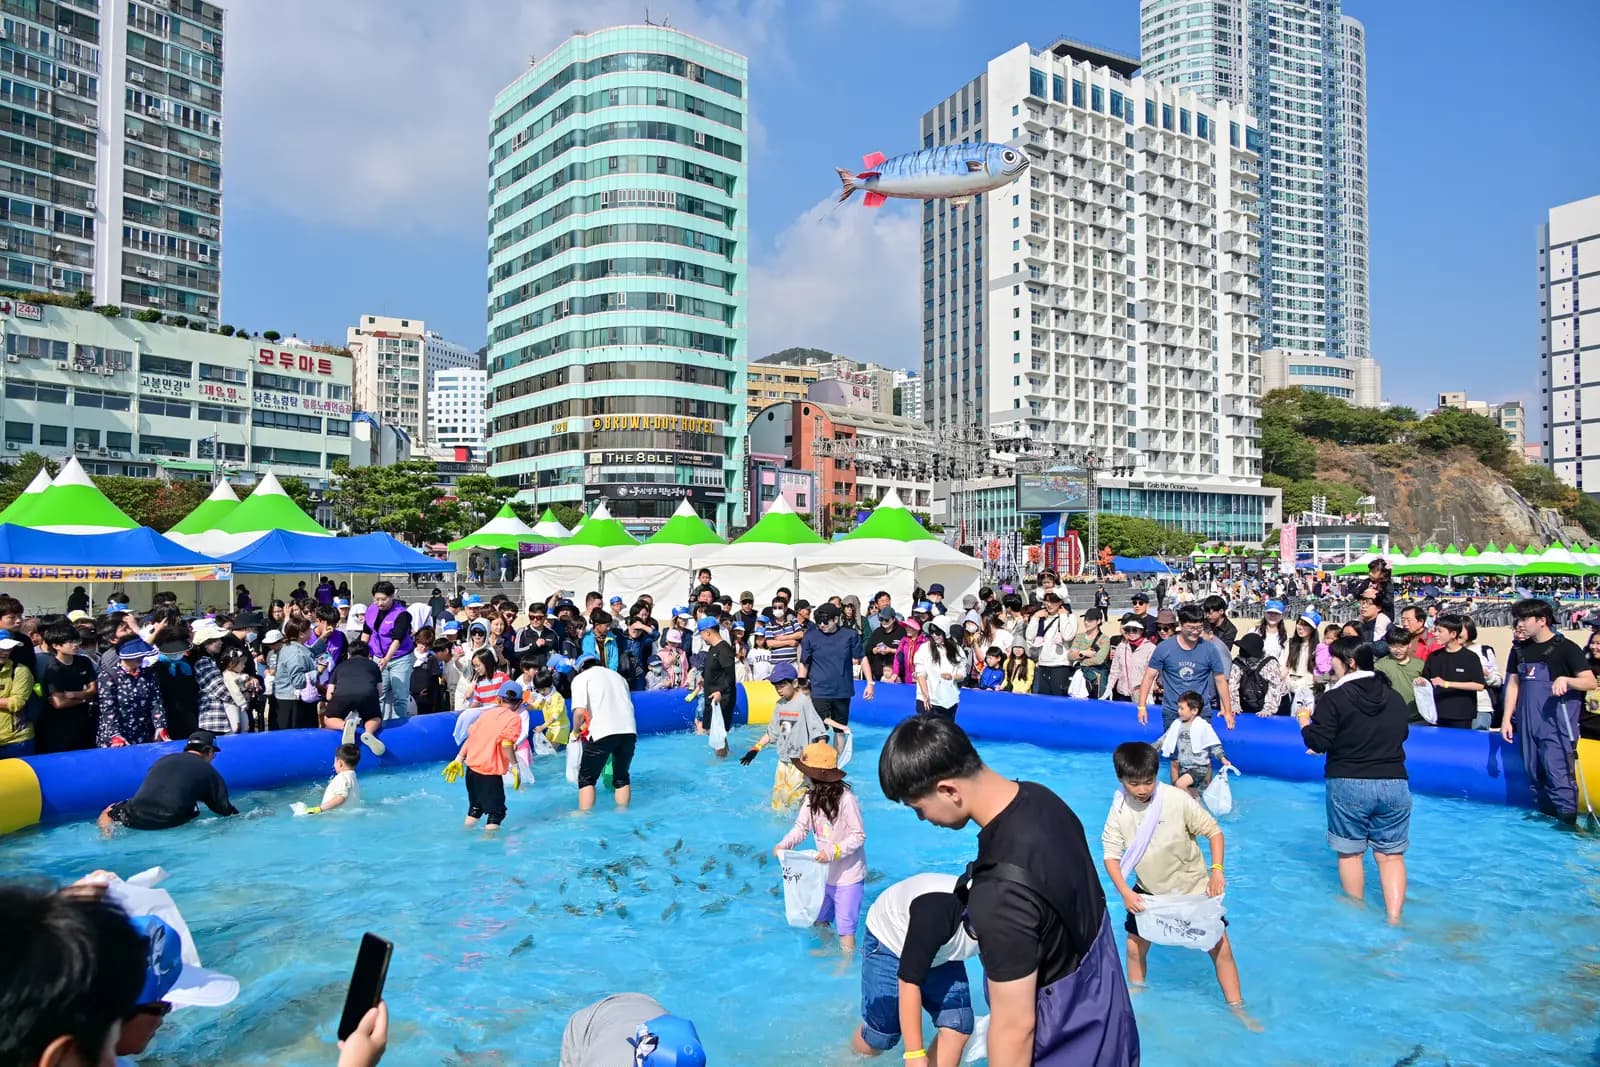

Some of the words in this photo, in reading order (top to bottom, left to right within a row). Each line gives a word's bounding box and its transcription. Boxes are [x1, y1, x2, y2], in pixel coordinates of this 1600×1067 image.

[259, 348, 332, 375] 모두마트
[681, 417, 715, 434] HOTEL
[606, 453, 633, 463] THE
[29, 567, 89, 579] 화덕구이
[95, 568, 123, 580] 체험
